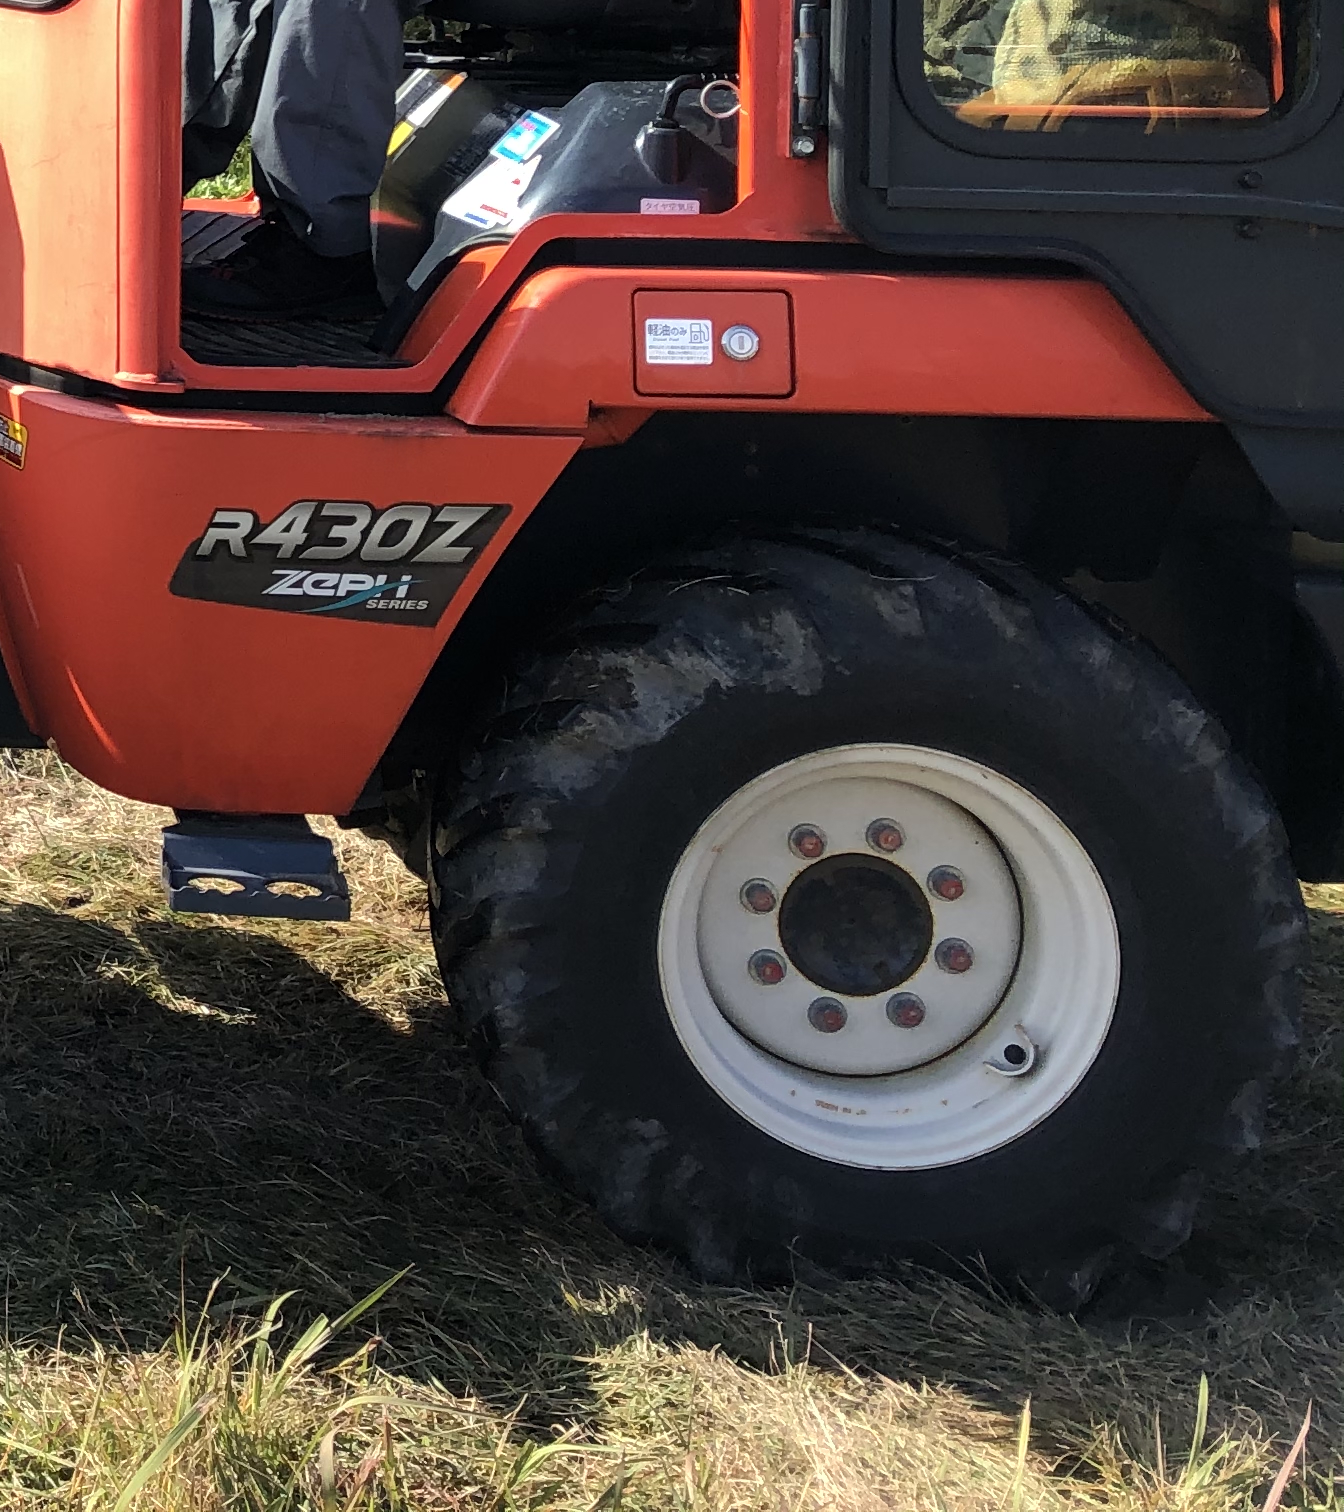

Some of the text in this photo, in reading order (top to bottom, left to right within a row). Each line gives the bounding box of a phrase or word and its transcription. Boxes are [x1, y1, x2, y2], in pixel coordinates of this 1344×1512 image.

[647, 324, 688, 336] 軽油のみ
[196, 501, 494, 563] R430Z
[365, 599, 430, 611] SERIES
